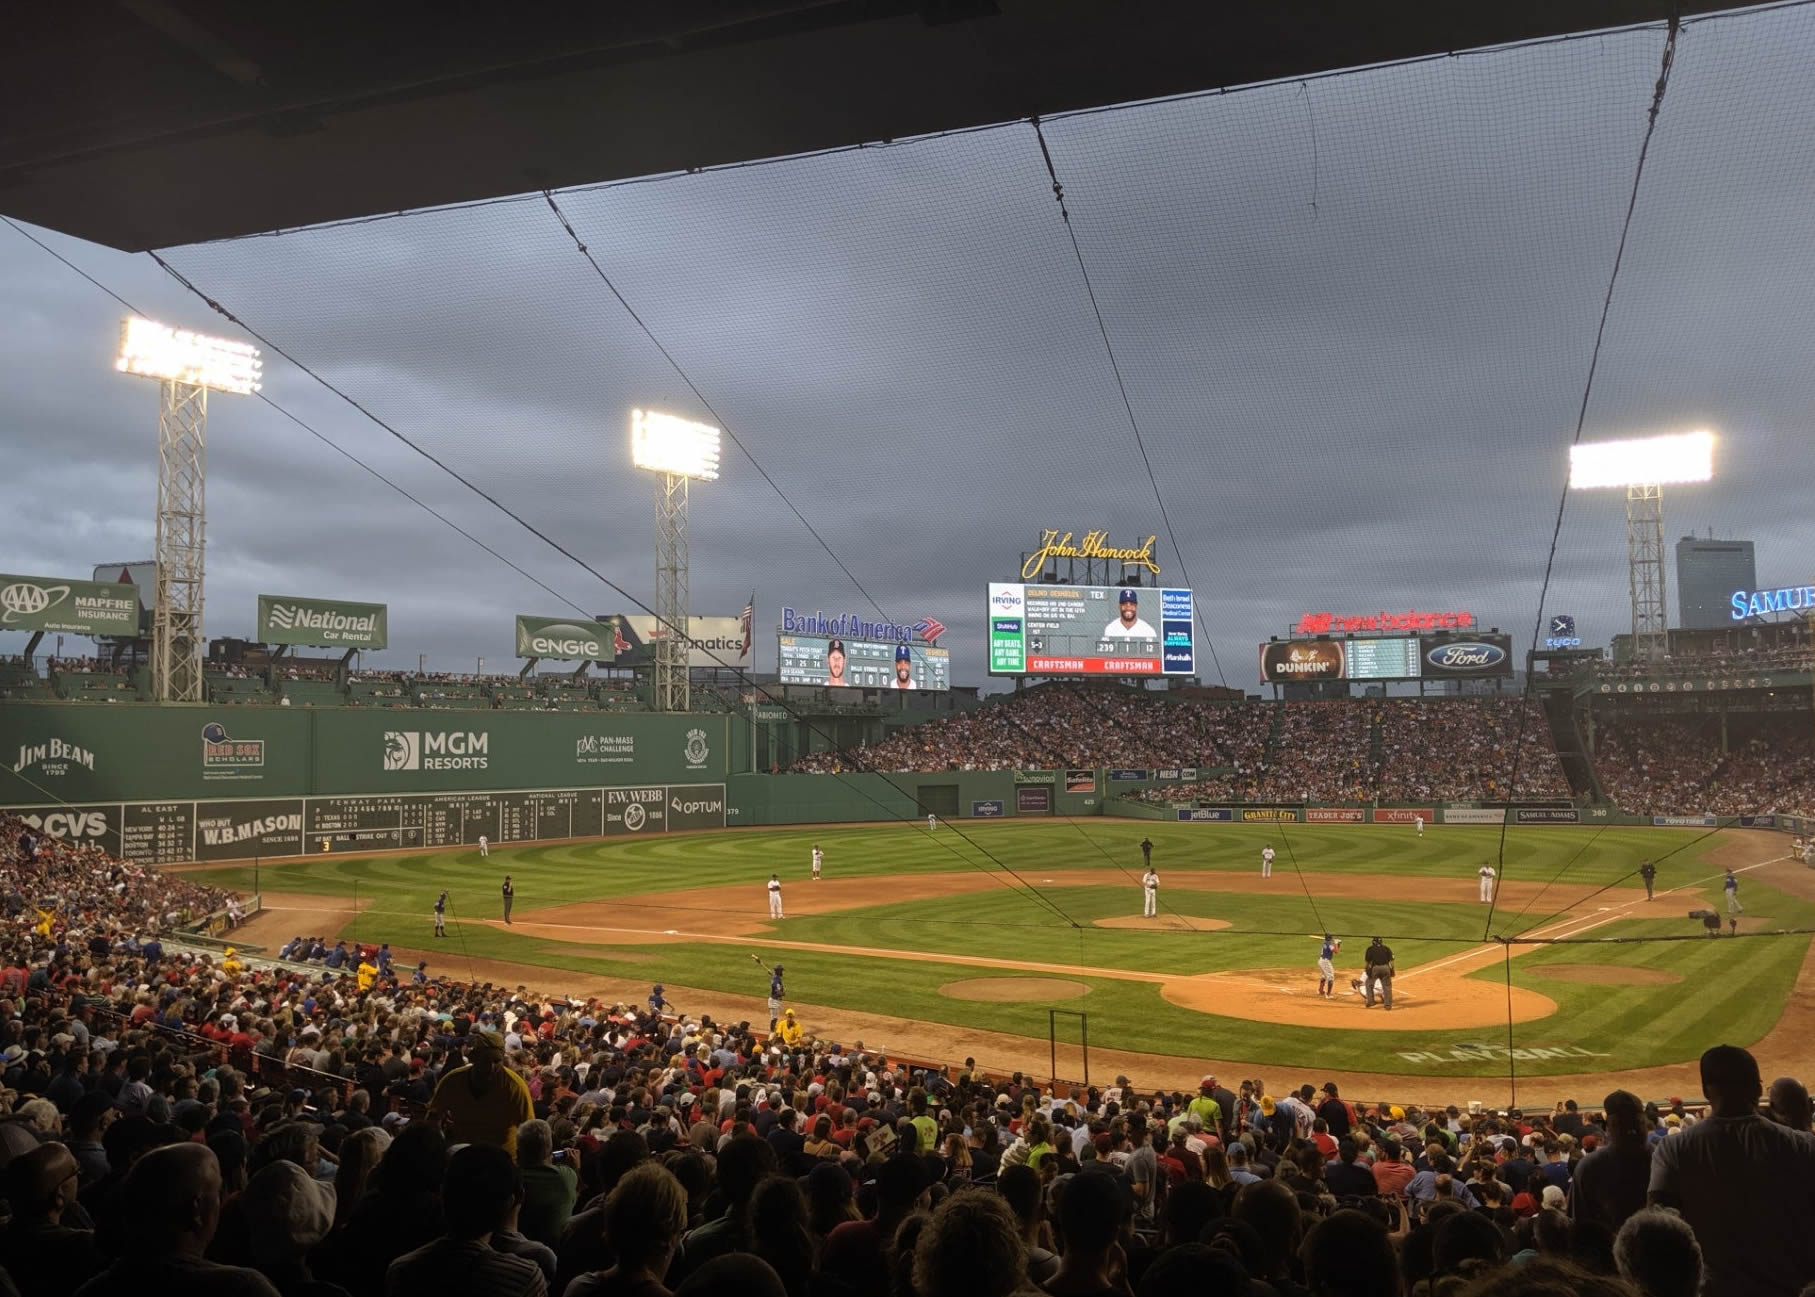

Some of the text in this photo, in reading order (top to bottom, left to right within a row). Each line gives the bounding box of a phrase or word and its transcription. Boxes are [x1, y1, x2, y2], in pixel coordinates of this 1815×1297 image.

[1022, 528, 1161, 579] John Hancock
[7, 584, 44, 612] AAA
[1090, 591, 1105, 599] TEX
[75, 597, 134, 610] MAPFRE
[992, 596, 1021, 605] IRVING
[78, 610, 129, 621] INSURANCE
[44, 622, 91, 631] Auto Insurance
[782, 607, 912, 642] Bank of America
[323, 631, 372, 641] Car Rental
[993, 640, 1004, 648] ANY
[1545, 637, 1581, 649] tyco
[1165, 653, 1192, 661] Marshalls
[1442, 647, 1490, 665] Ford
[996, 658, 1007, 666] ANY
[1033, 660, 1154, 670] CRAFTSMAN CRAFTSMAN
[1276, 662, 1330, 673] DUNKIN'
[854, 674, 888, 685] 0 0 0
[424, 732, 489, 755] MGM
[600, 736, 634, 745] PAN-MASS
[600, 745, 634, 753] CHALLENGE
[14, 738, 95, 773] JIM BEAM
[424, 757, 488, 770] RESORTS
[1160, 770, 1179, 779] NESN
[629, 790, 663, 802] WEBB
[155, 805, 178, 813] EAST
[683, 800, 722, 814] OPTUM
[727, 808, 739, 816] 379
[607, 813, 622, 821] Since
[1190, 809, 1220, 820] jetBlue
[1279, 810, 1296, 820] CITY
[1519, 811, 1576, 820] SAMUEL ADAMS
[44, 812, 107, 839] CVS
[198, 818, 232, 828] WHO BUT
[262, 836, 283, 844] SINCE
[322, 841, 330, 852] 3
[1396, 1046, 1612, 1064] PLAY BALL
